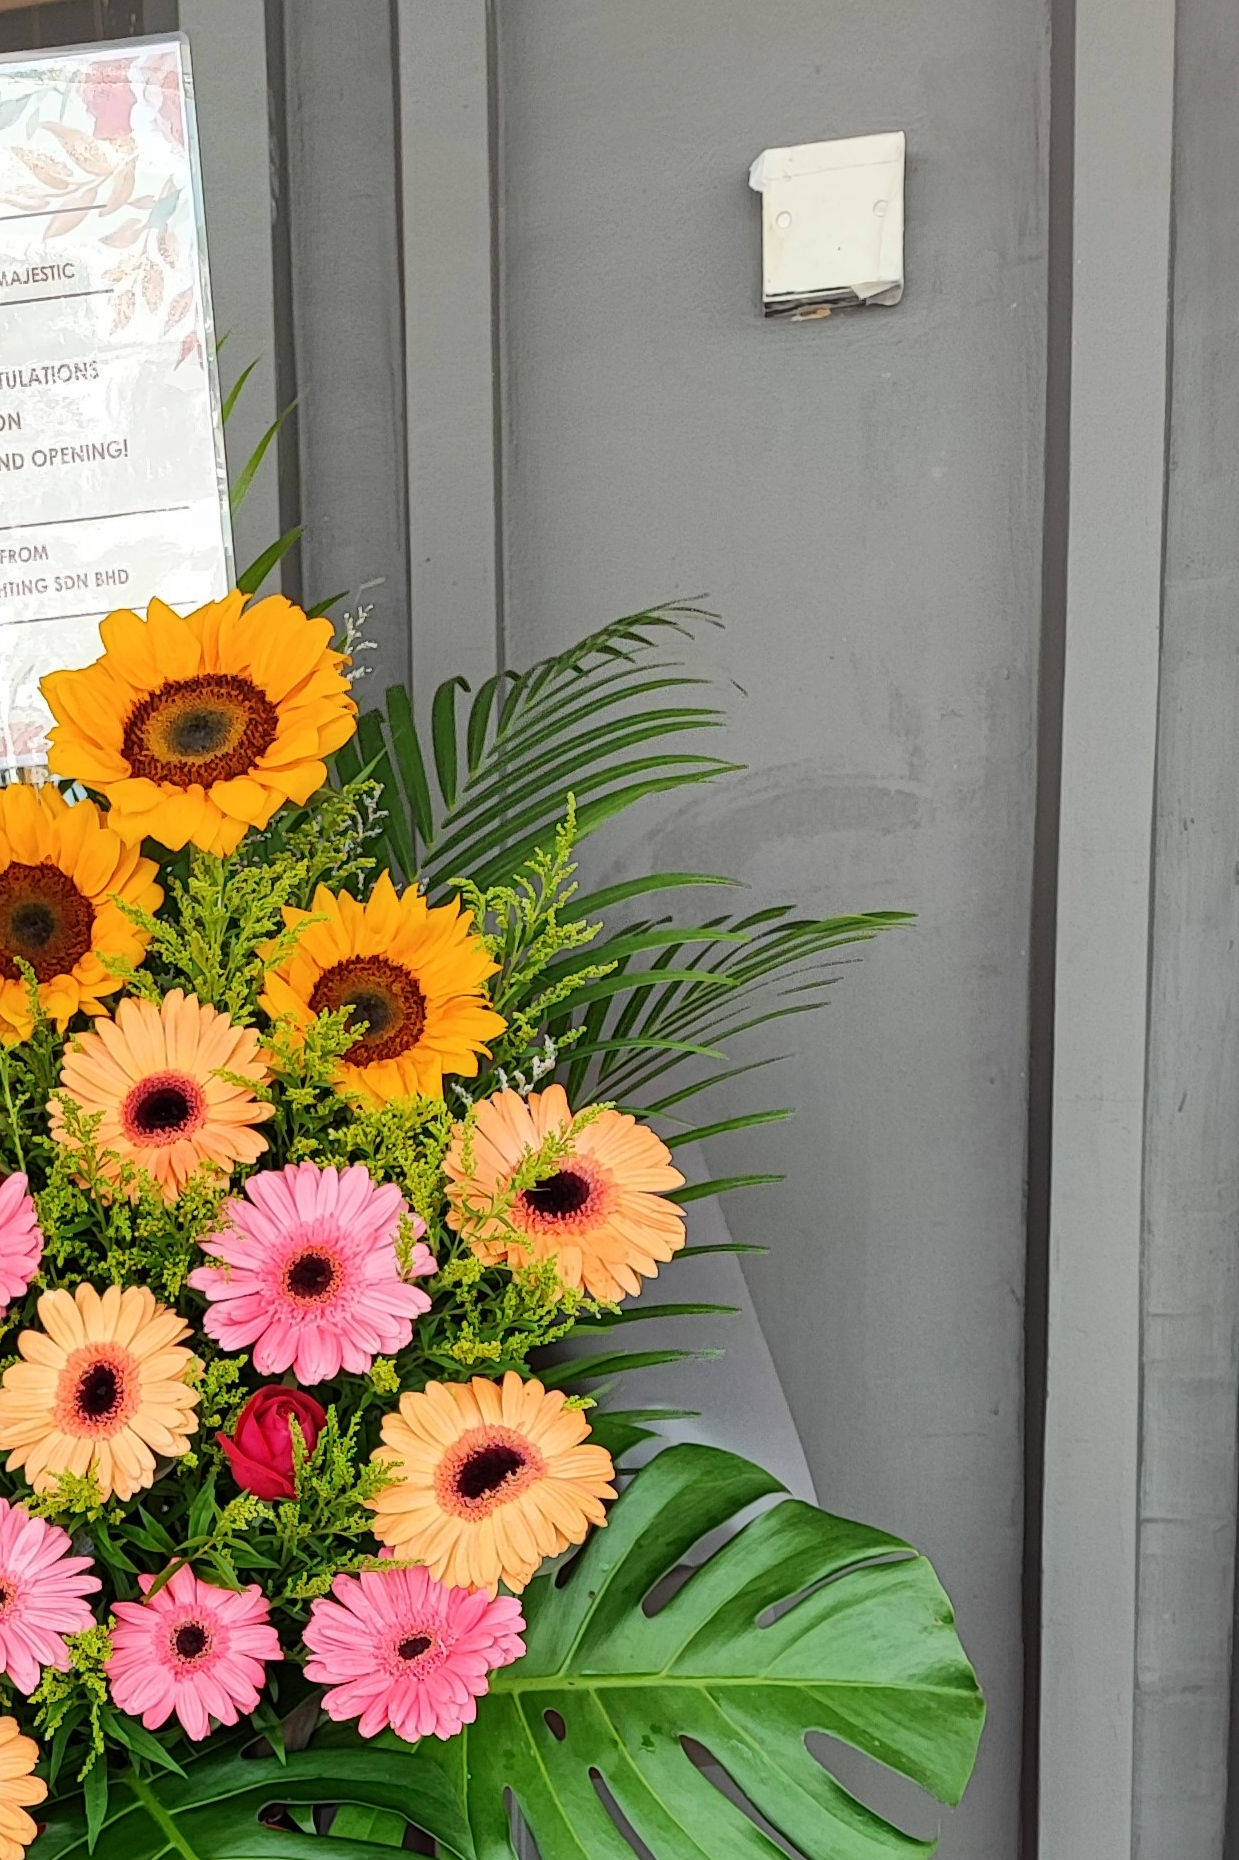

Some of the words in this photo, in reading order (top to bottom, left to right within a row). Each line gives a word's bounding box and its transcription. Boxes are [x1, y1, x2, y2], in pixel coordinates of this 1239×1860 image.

[31, 438, 129, 468] OPENING!
[54, 572, 88, 593] SDN
[95, 568, 130, 587] BHD
